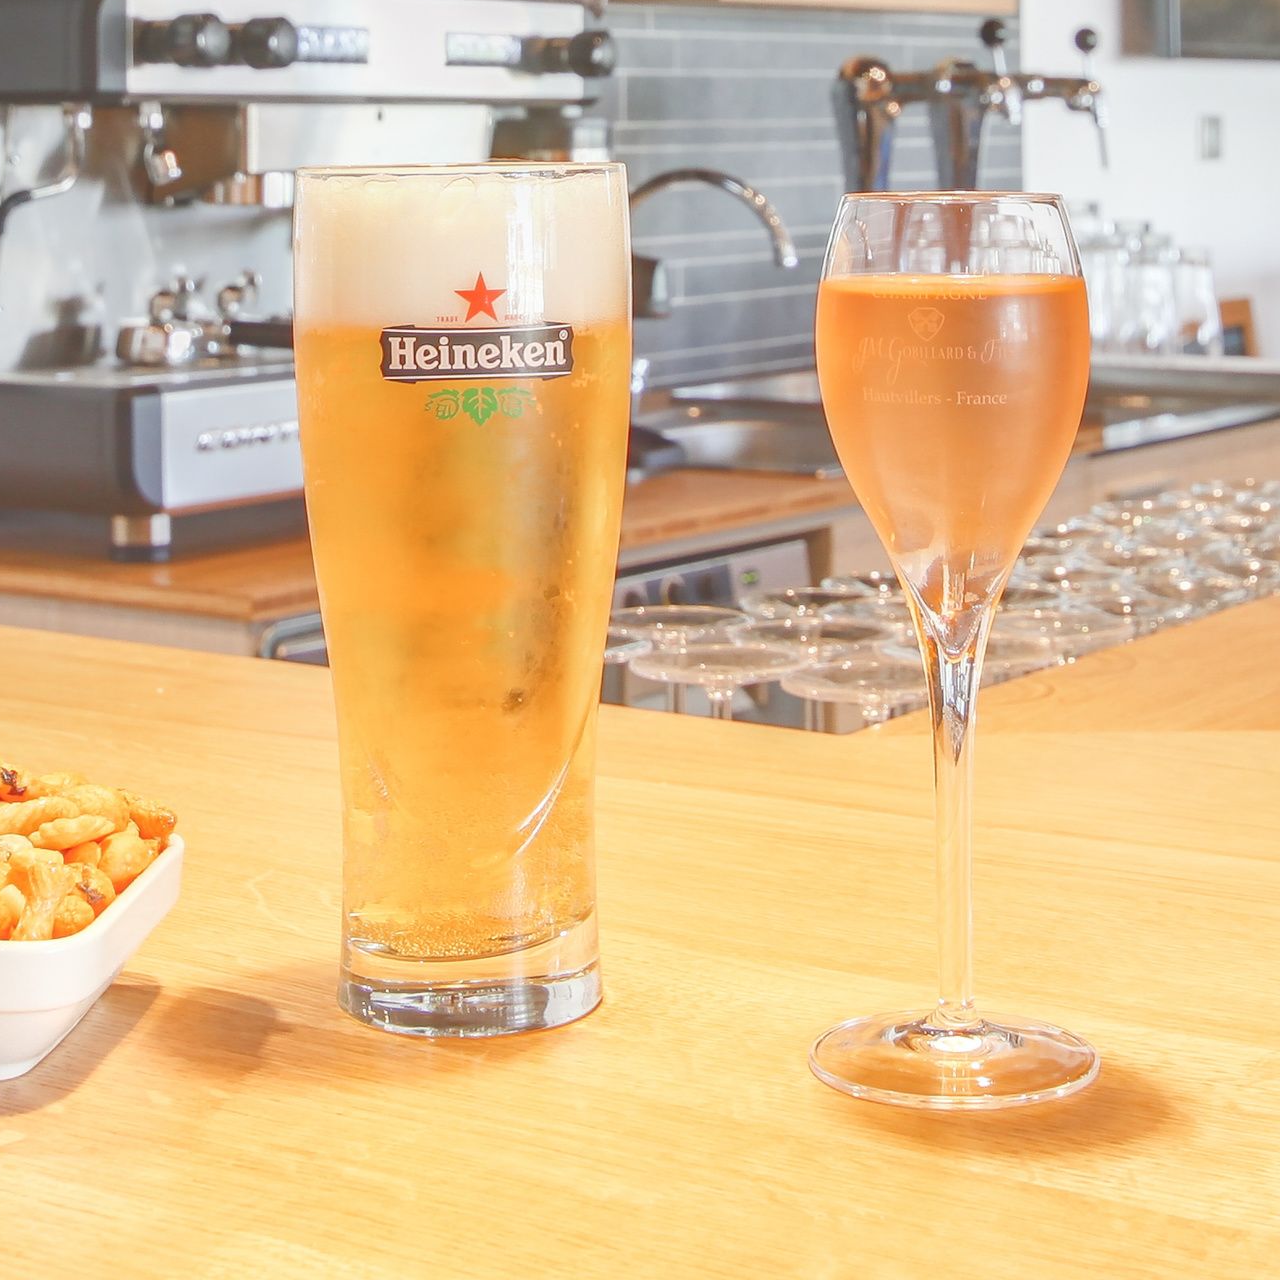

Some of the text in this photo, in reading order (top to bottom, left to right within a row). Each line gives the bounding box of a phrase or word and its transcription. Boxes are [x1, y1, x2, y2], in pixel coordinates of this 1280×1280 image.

[388, 335, 567, 371] Heineken
[967, 344, 976, 360] &
[956, 390, 1008, 405] France
